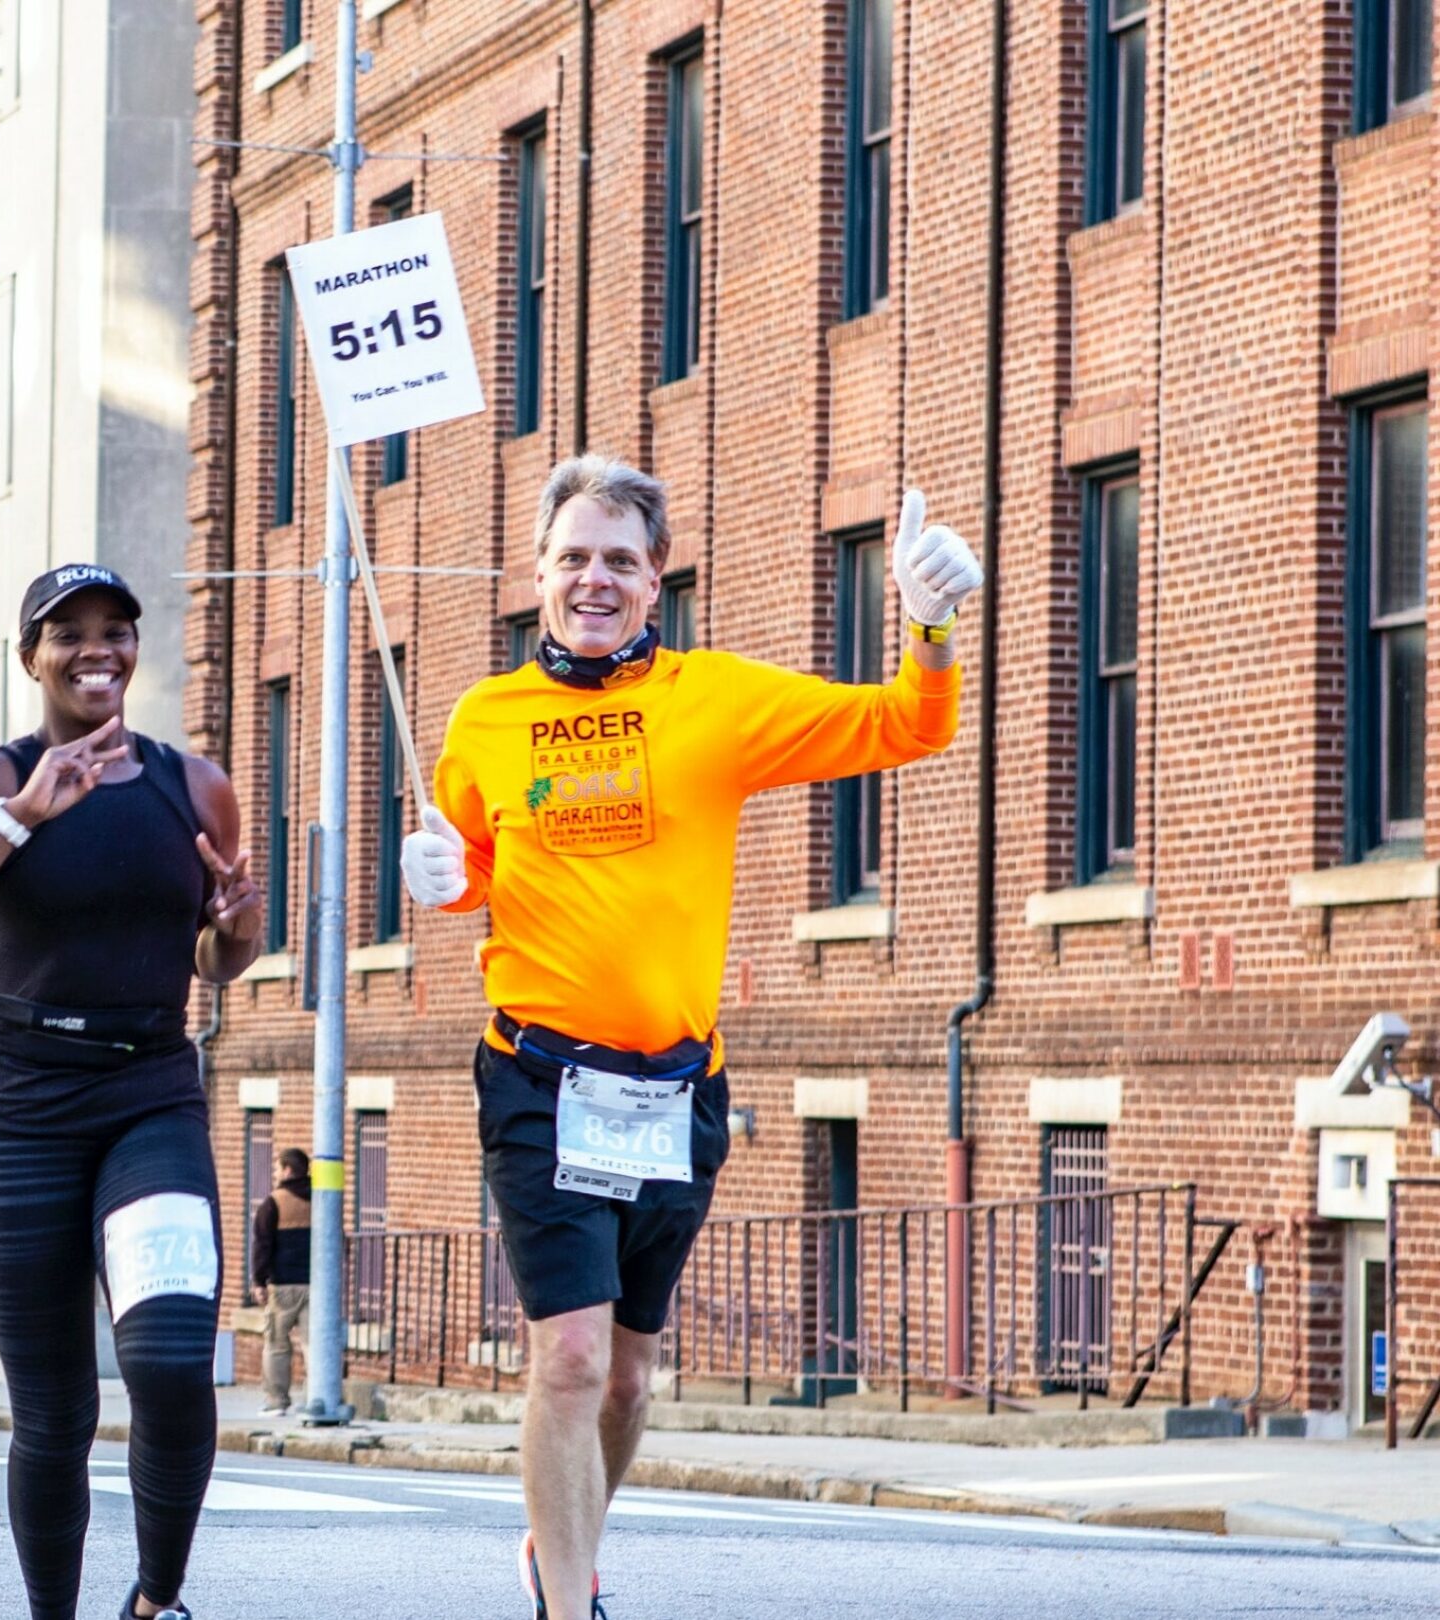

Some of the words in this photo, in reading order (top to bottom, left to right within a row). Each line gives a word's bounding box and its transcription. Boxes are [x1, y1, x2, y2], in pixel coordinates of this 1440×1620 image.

[315, 254, 429, 295] MARATHON
[330, 300, 442, 361] 5:15
[351, 392, 372, 403] You
[375, 385, 400, 397] Can.
[404, 379, 423, 391] You
[531, 711, 644, 747] PACER
[538, 745, 637, 765] RALEIGH
[577, 764, 603, 774] CITY
[607, 762, 621, 771] OF
[557, 767, 642, 802] OAKS
[544, 802, 643, 828] MARATHON
[583, 1114, 673, 1157] 8376
